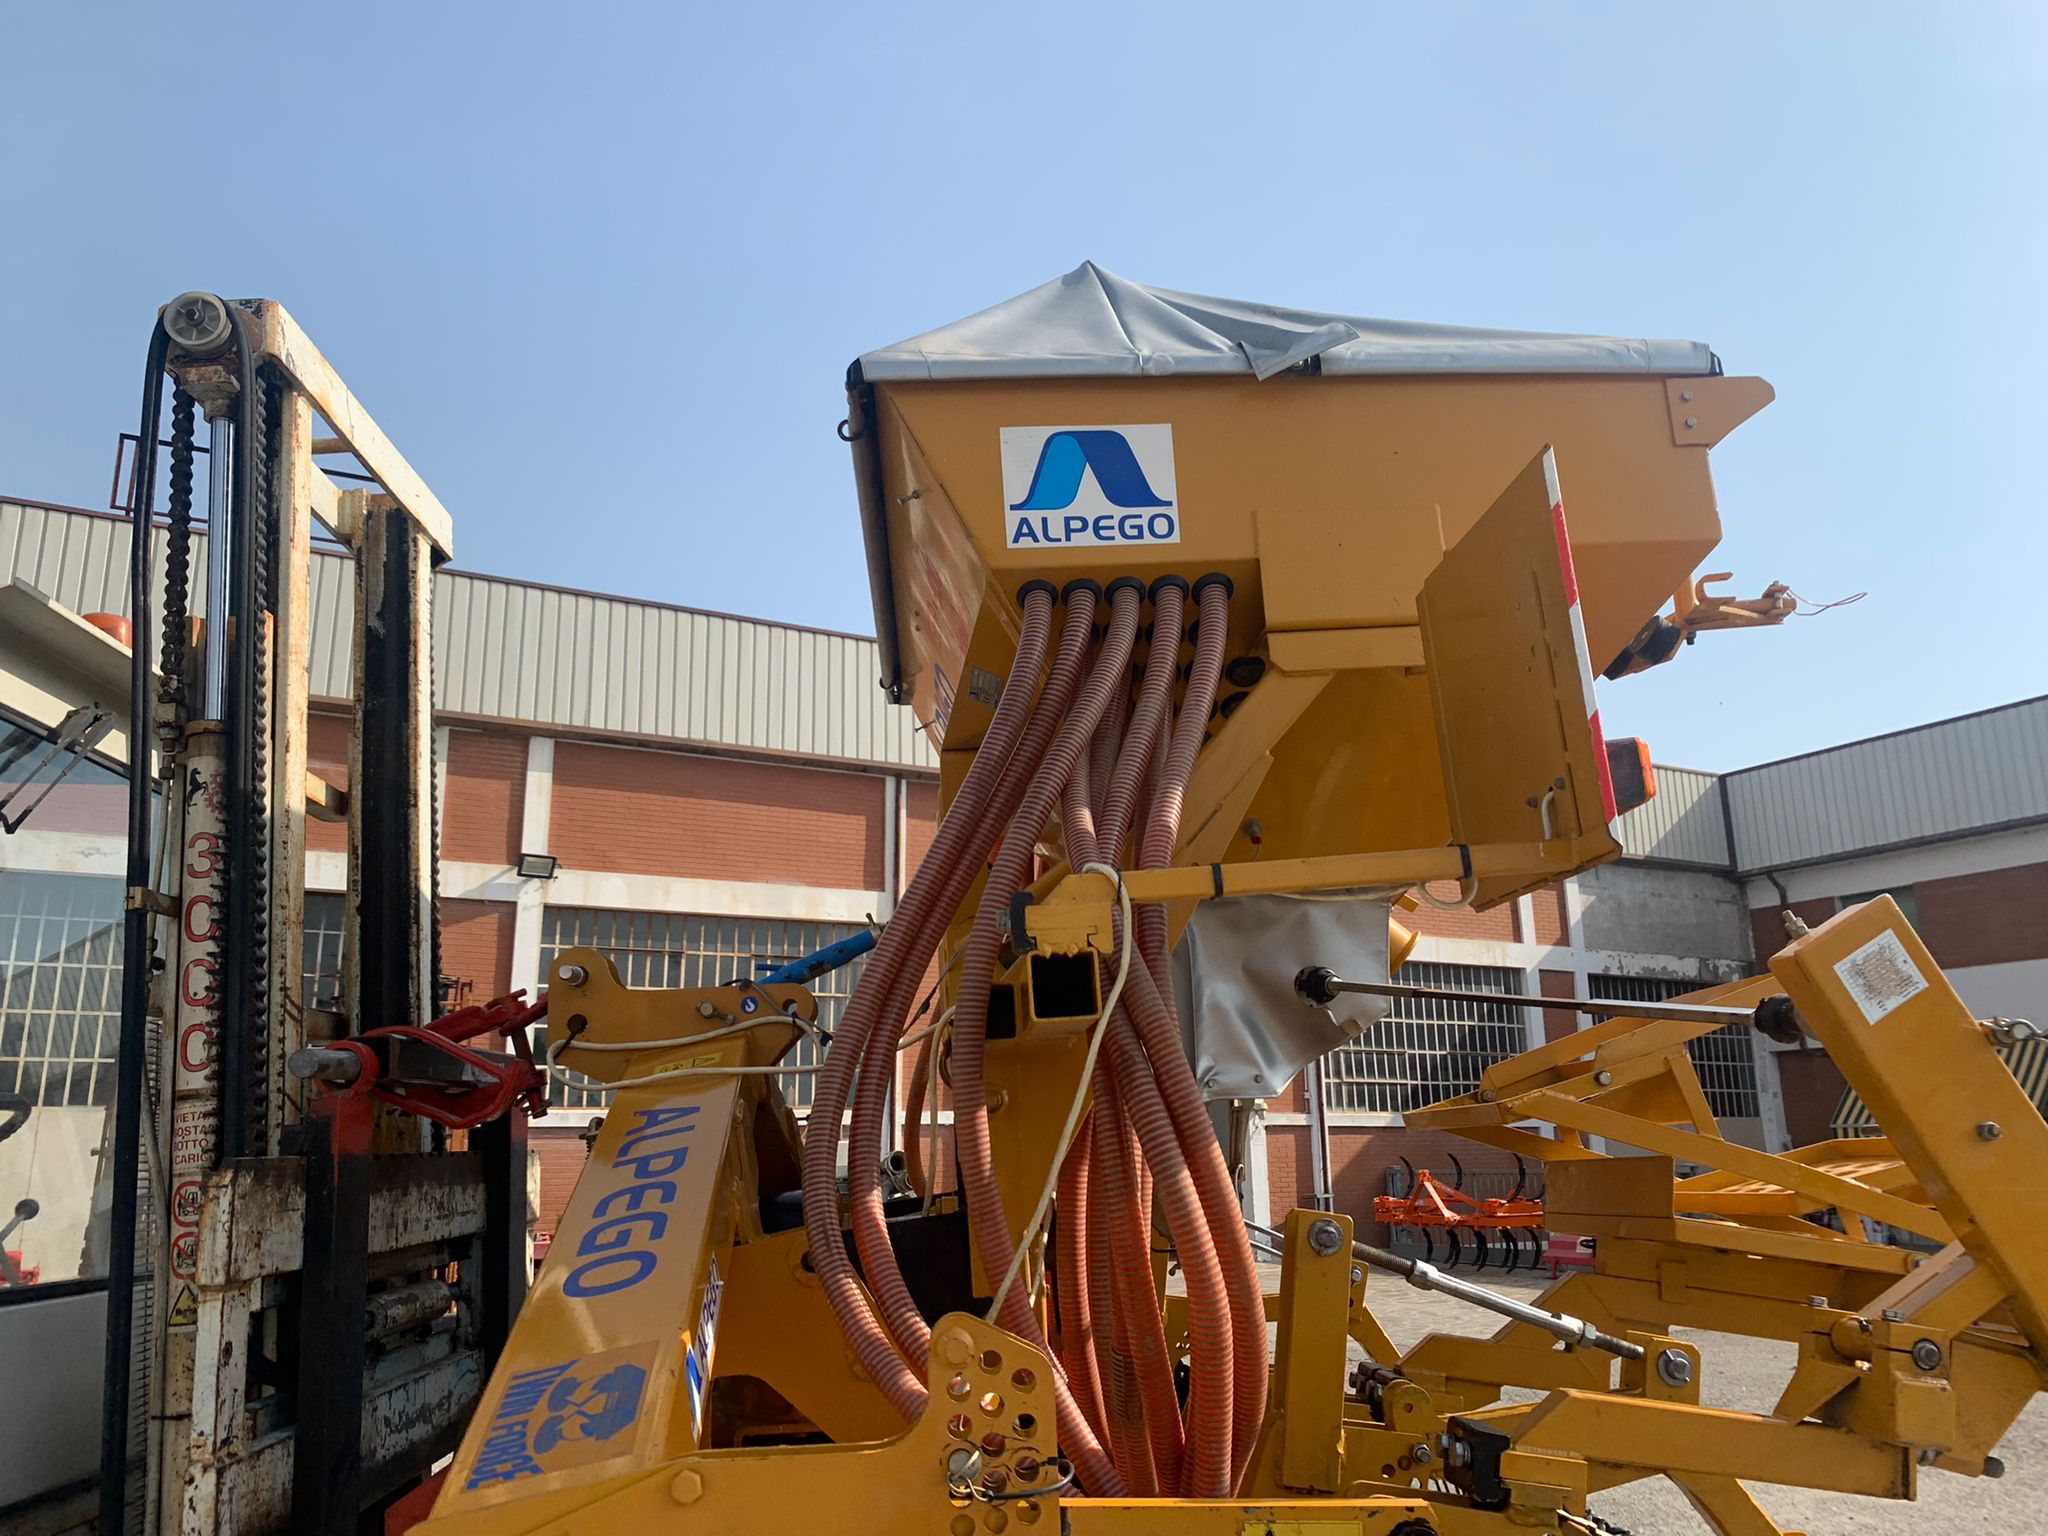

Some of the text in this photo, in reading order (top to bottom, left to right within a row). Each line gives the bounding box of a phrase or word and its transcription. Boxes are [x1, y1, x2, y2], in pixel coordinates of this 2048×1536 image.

[1012, 513, 1175, 544] ALPEGO
[176, 1110, 216, 1123] VIETA
[562, 1105, 701, 1298] ALPEGO
[466, 1419, 543, 1490] FORCE
